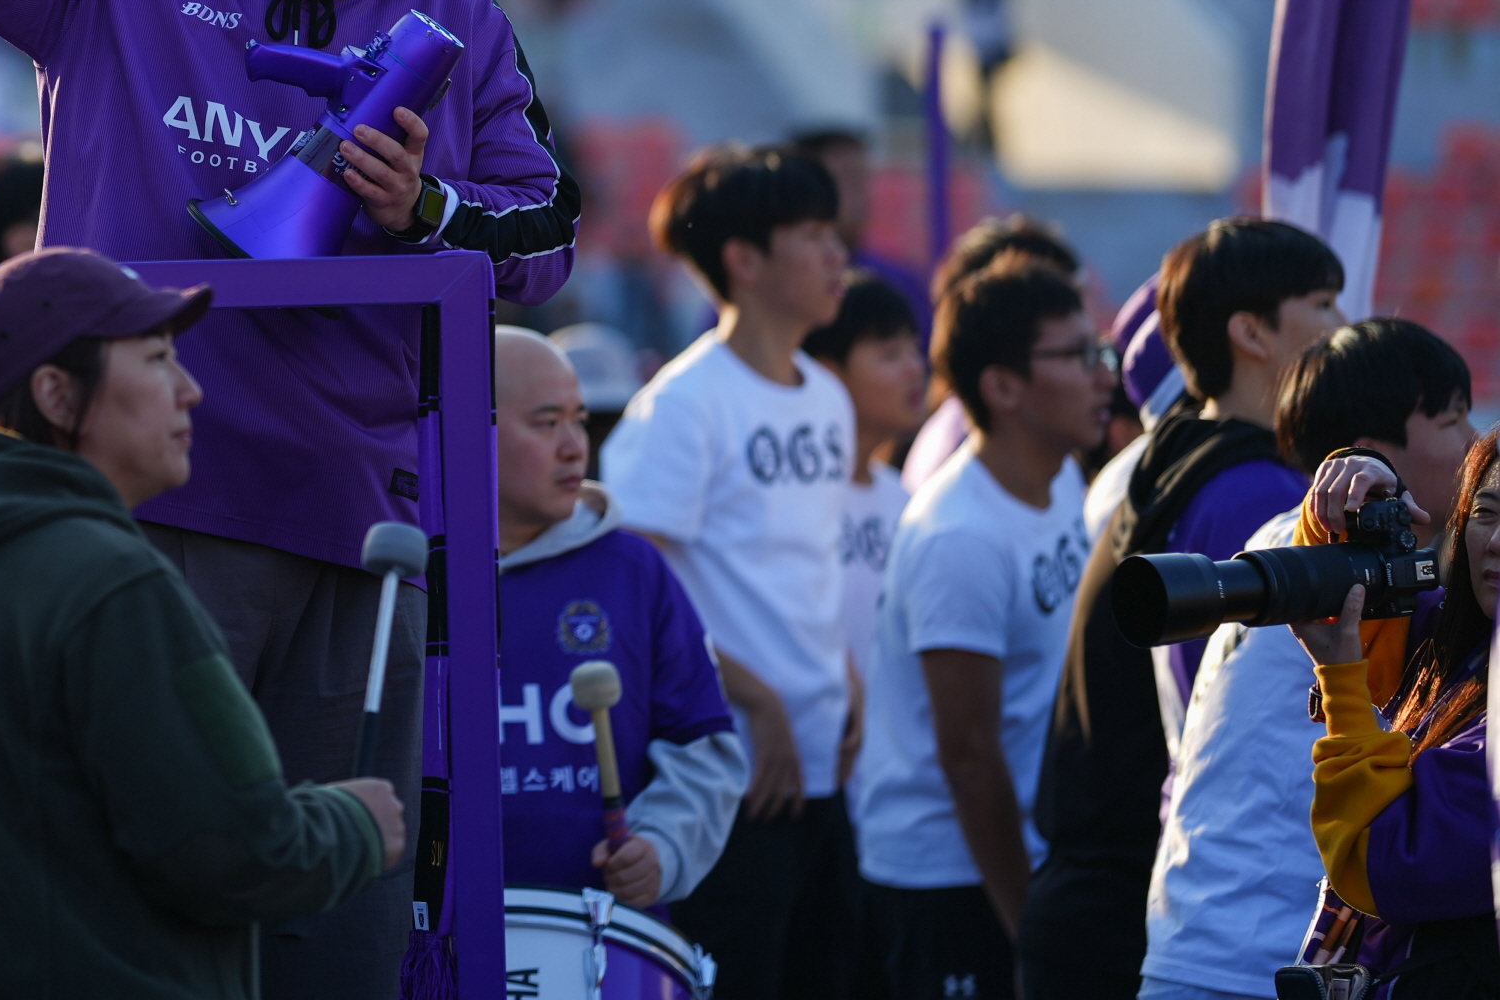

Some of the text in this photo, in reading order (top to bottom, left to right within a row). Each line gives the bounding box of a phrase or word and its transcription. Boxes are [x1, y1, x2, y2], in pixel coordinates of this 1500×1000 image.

[180, 1, 243, 29] BDNS
[177, 144, 269, 174] FOOTB
[1385, 562, 1393, 587] Canon
